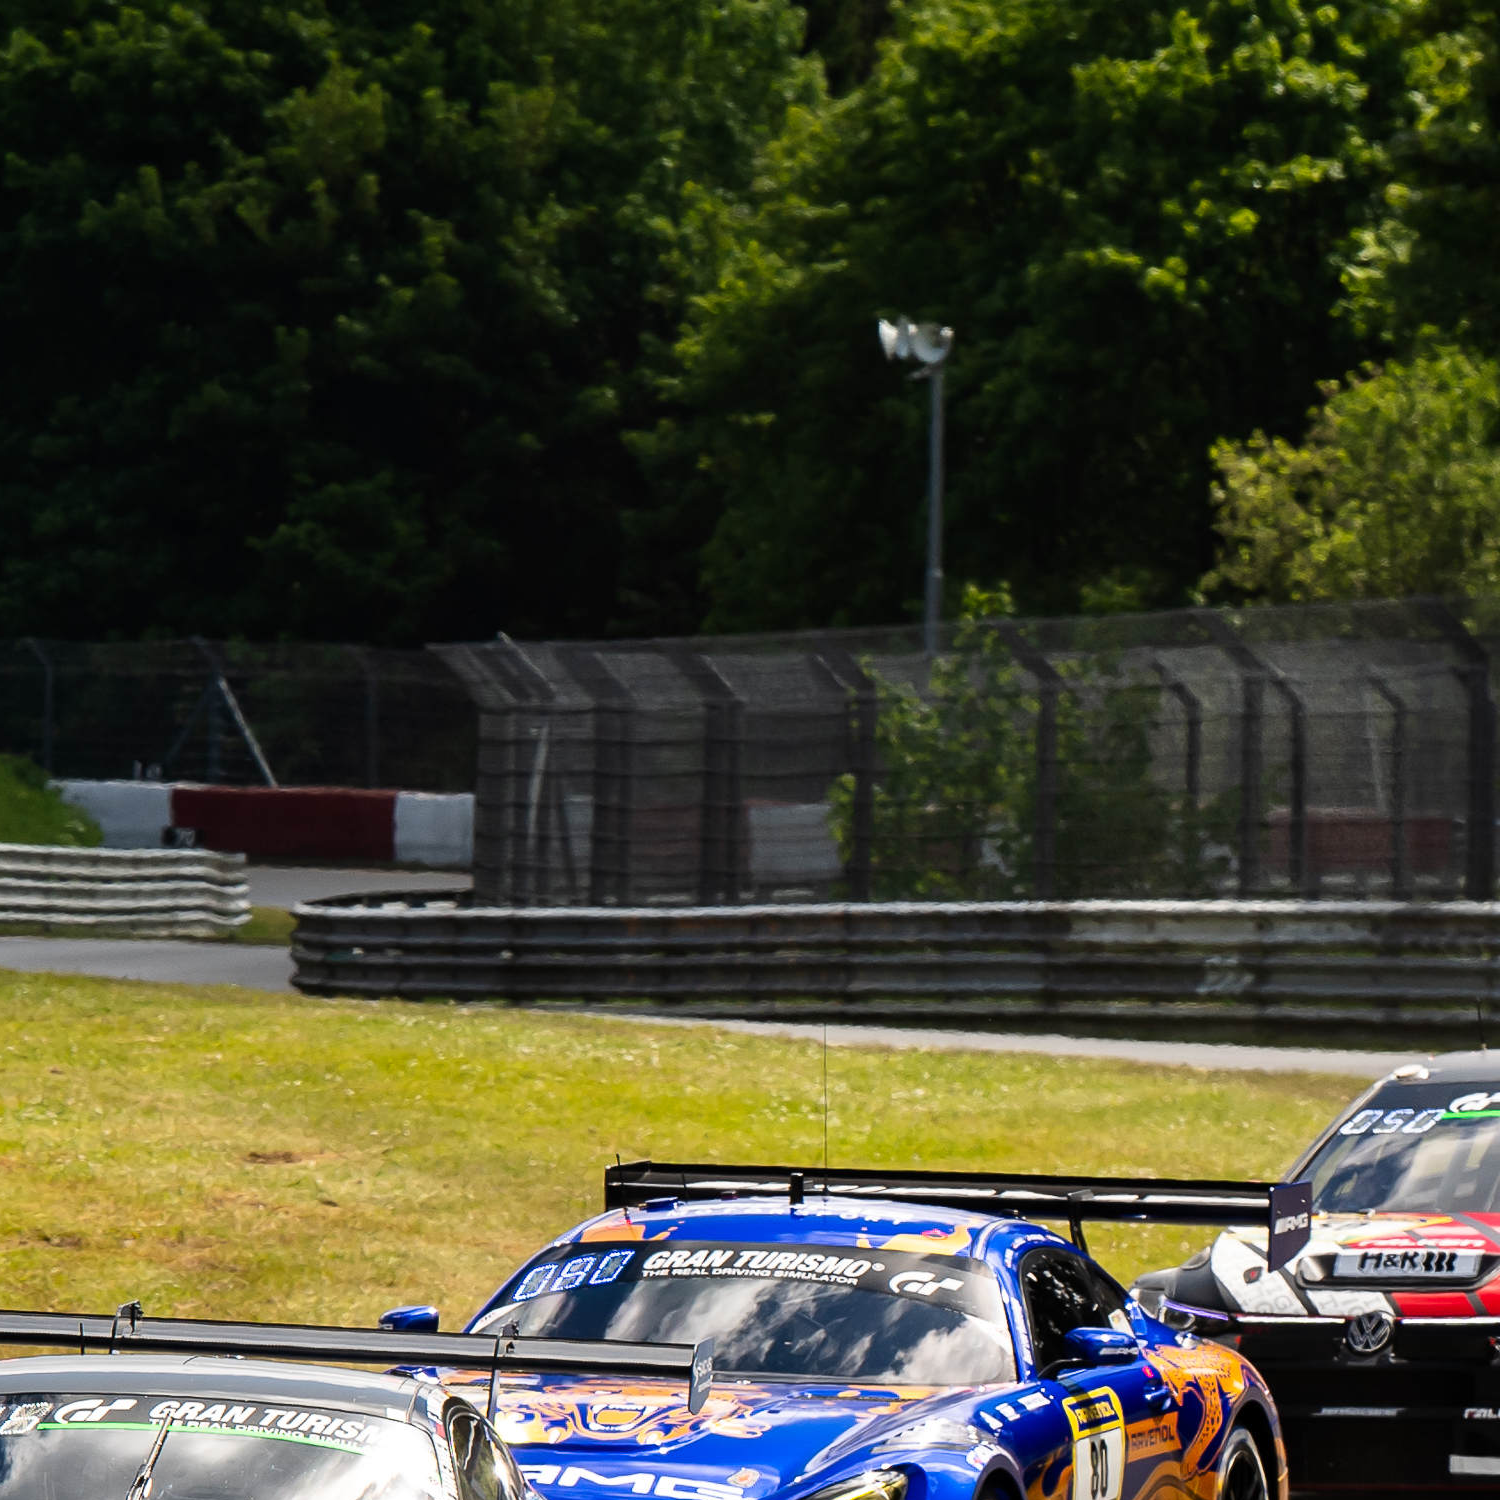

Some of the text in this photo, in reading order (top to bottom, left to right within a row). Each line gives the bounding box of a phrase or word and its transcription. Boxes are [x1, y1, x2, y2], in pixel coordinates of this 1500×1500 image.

[642, 1250, 873, 1278] GRAN TURISMO
[642, 1268, 859, 1286] THE REAL DRIVING SIMULATOR
[148, 1400, 256, 1424] GRAN
[1090, 1438, 1109, 1500] 80
